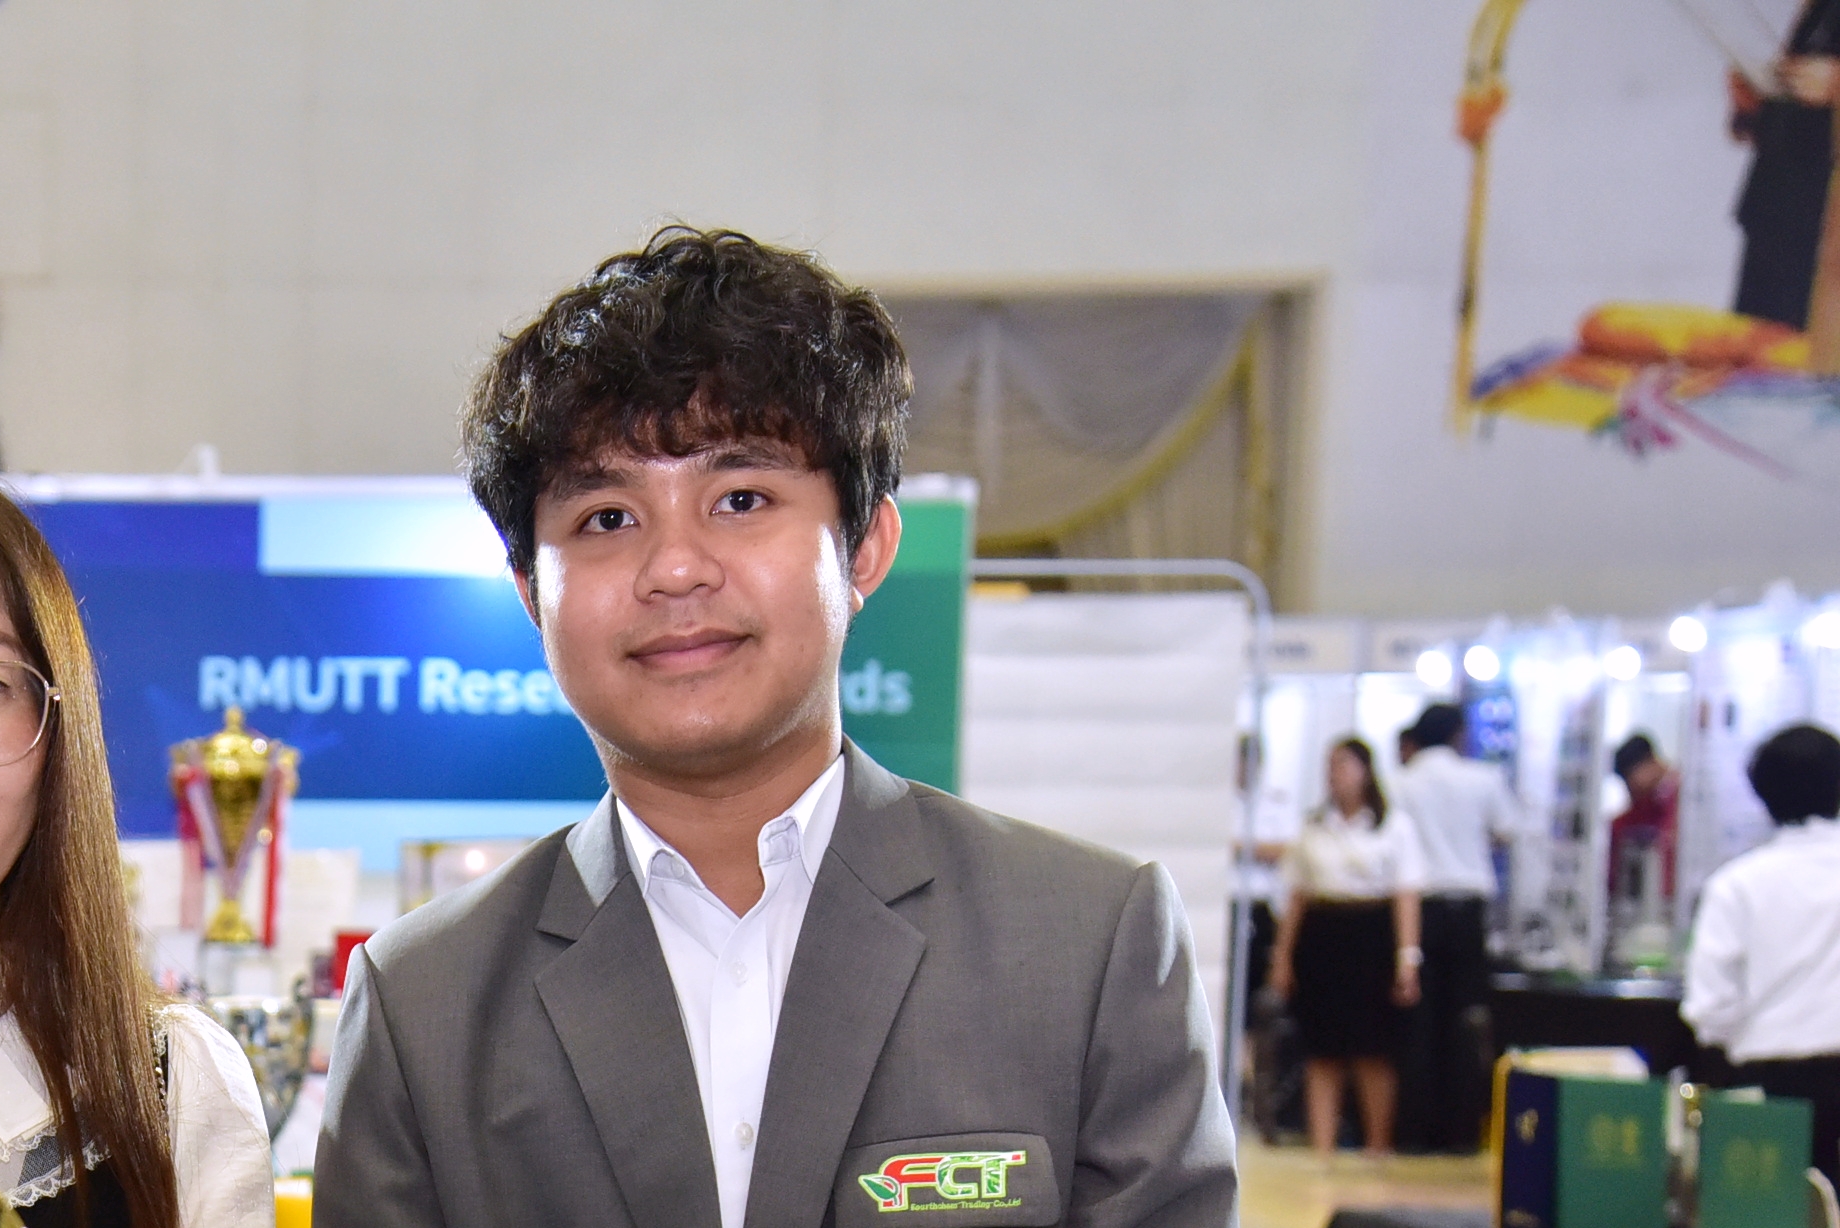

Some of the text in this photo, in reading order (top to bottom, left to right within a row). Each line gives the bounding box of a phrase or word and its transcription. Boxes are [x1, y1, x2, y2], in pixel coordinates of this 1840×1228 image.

[198, 655, 410, 714] RMUTT
[418, 657, 572, 715] Rese
[959, 1200, 992, 1209] Trading
